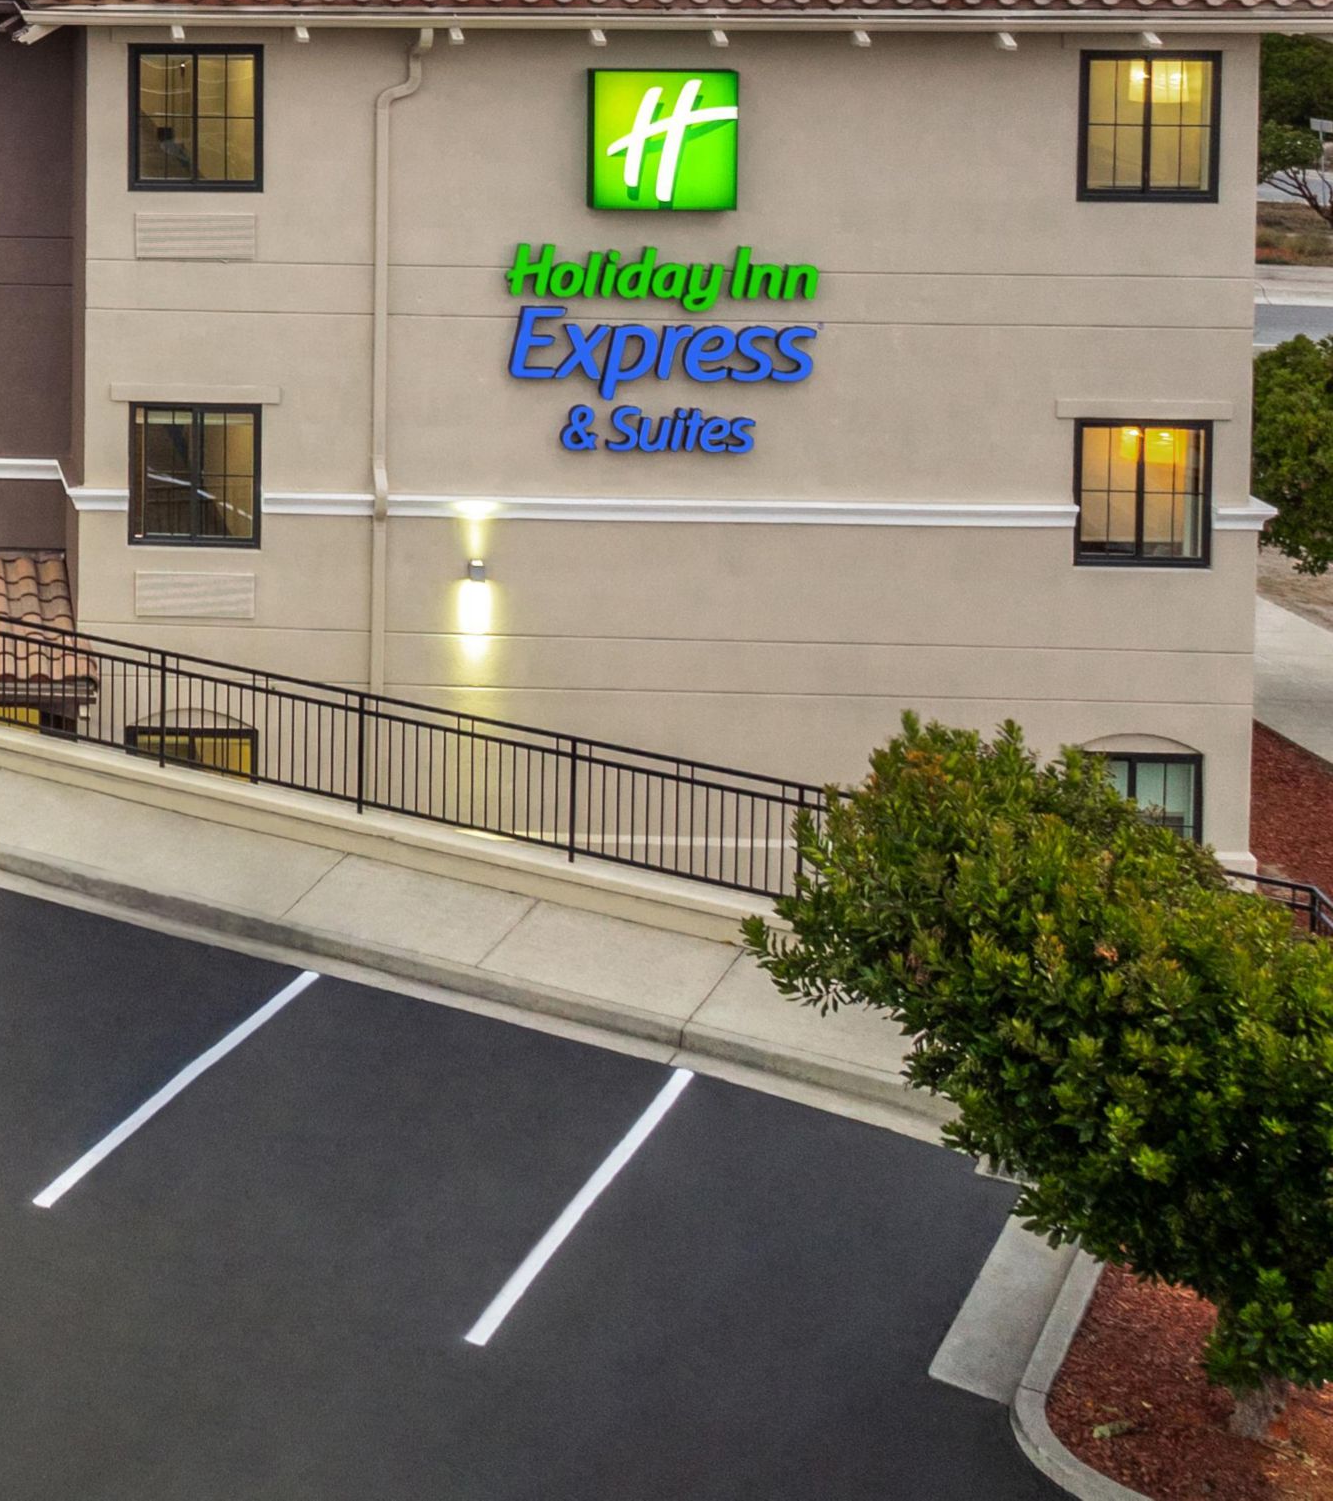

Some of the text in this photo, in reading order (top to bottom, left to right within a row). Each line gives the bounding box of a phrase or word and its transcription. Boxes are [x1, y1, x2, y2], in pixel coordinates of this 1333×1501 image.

[506, 243, 820, 312] Holiday Inn
[508, 305, 818, 401] Express
[560, 404, 756, 454] & Suites
